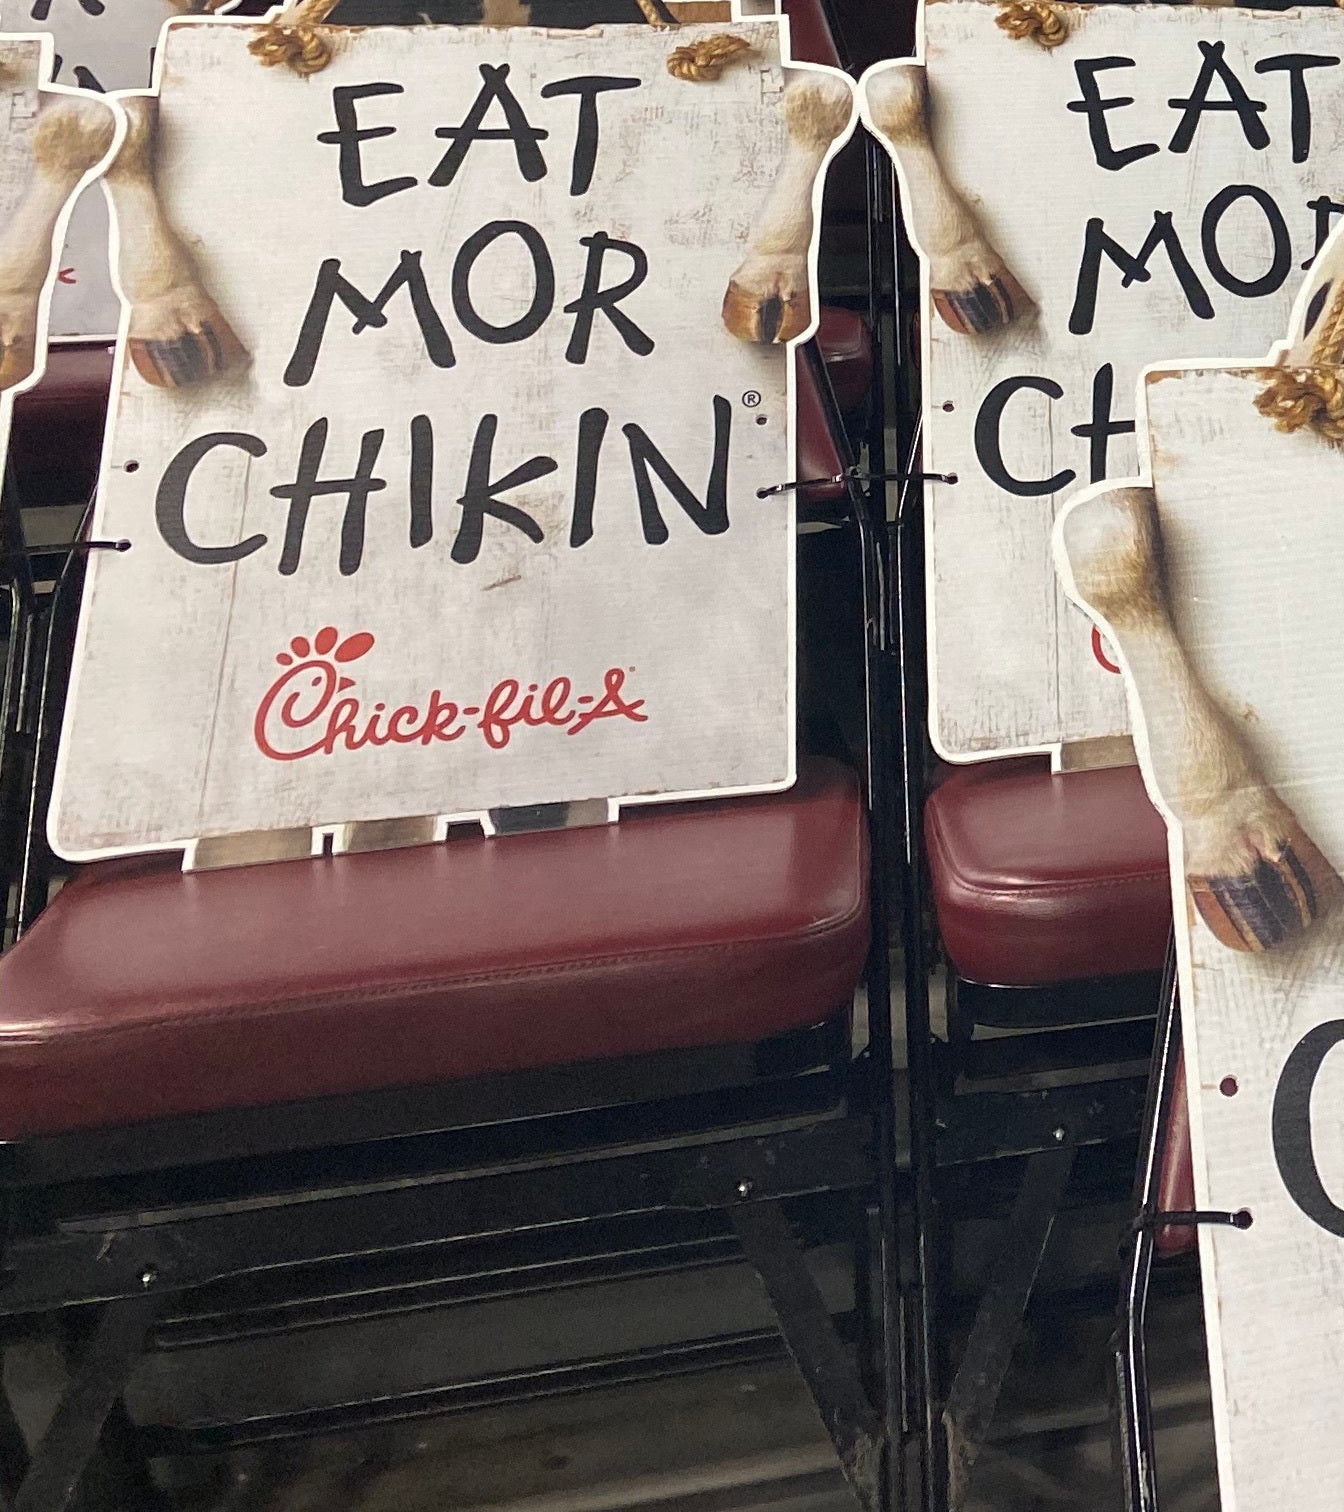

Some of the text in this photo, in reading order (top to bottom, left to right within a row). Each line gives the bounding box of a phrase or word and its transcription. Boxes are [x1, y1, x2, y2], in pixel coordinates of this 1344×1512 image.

[316, 63, 642, 208] EAT
[1066, 40, 1341, 171] EAT
[282, 219, 655, 387] MOR
[154, 394, 732, 577] CHIKIN
[253, 626, 648, 762] Chick-fil-A
